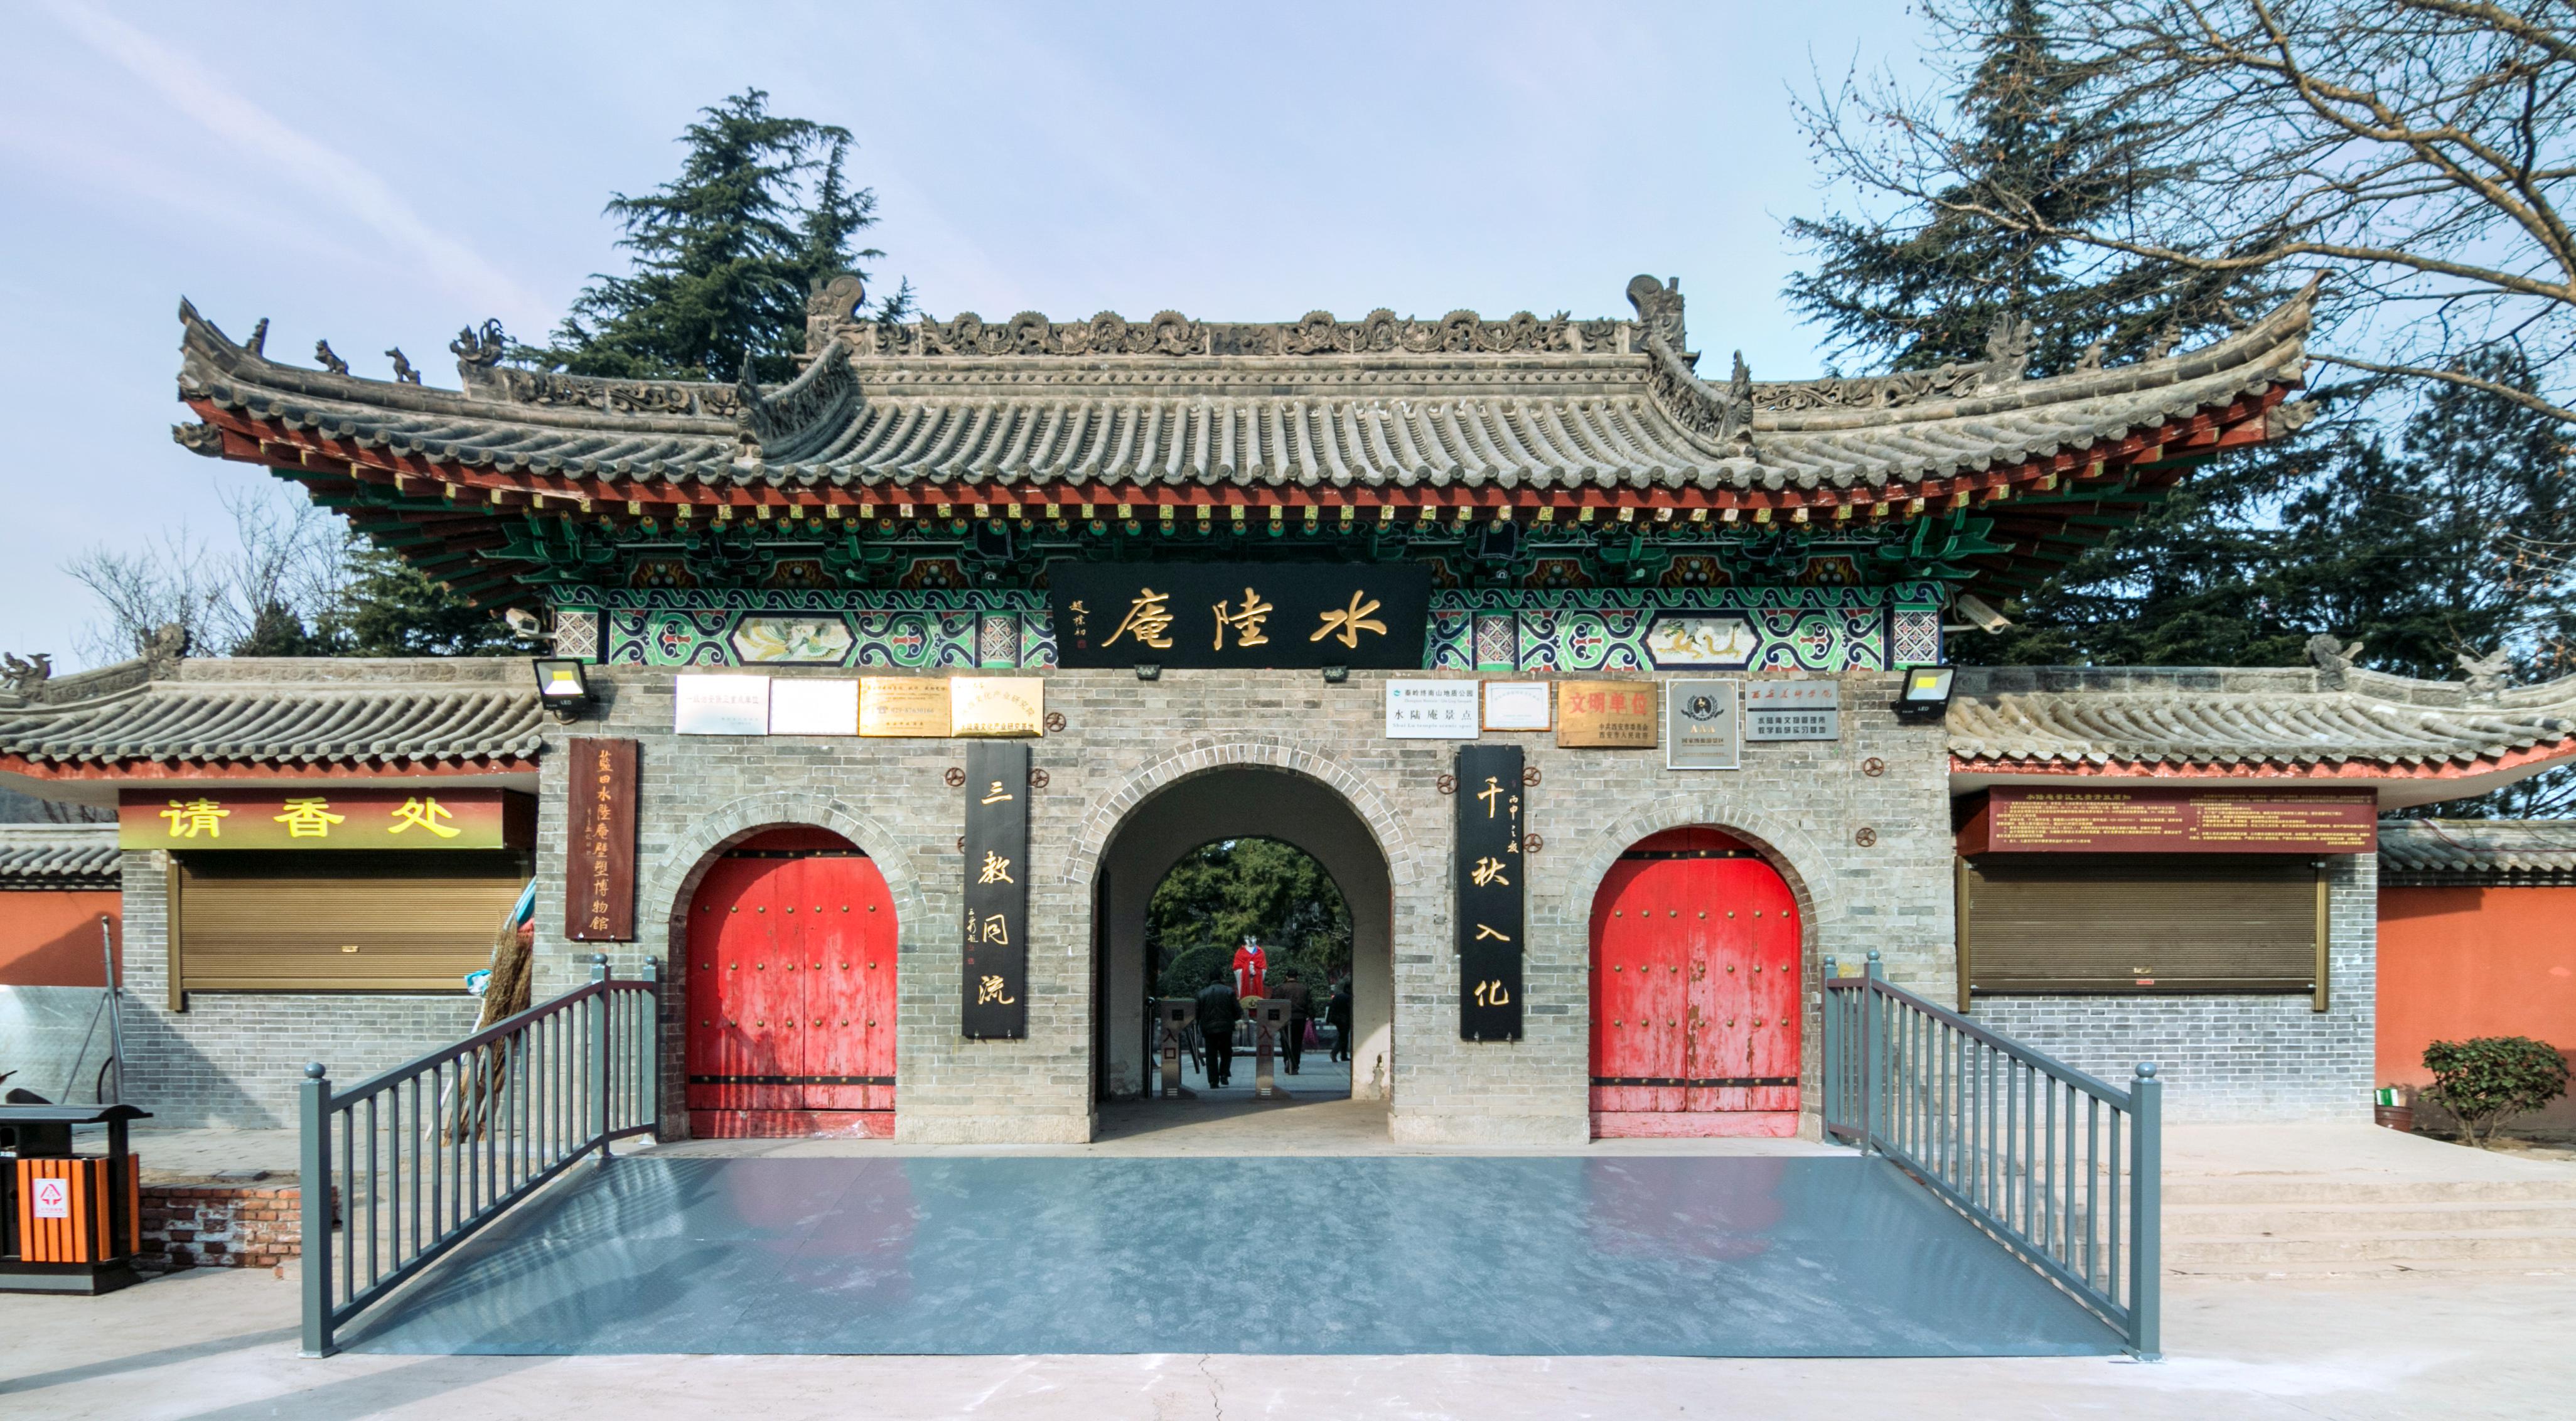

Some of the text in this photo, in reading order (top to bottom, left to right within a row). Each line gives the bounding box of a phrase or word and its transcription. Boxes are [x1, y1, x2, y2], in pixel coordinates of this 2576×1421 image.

[1394, 709, 1471, 721] 水陆庵景点
[1569, 692, 1648, 714] 文明单位
[159, 796, 461, 838] 请香处
[1471, 776, 1510, 1007] 千秋入化
[1163, 1027, 1177, 1059] 入口
[1258, 1025, 1272, 1056] 入口
